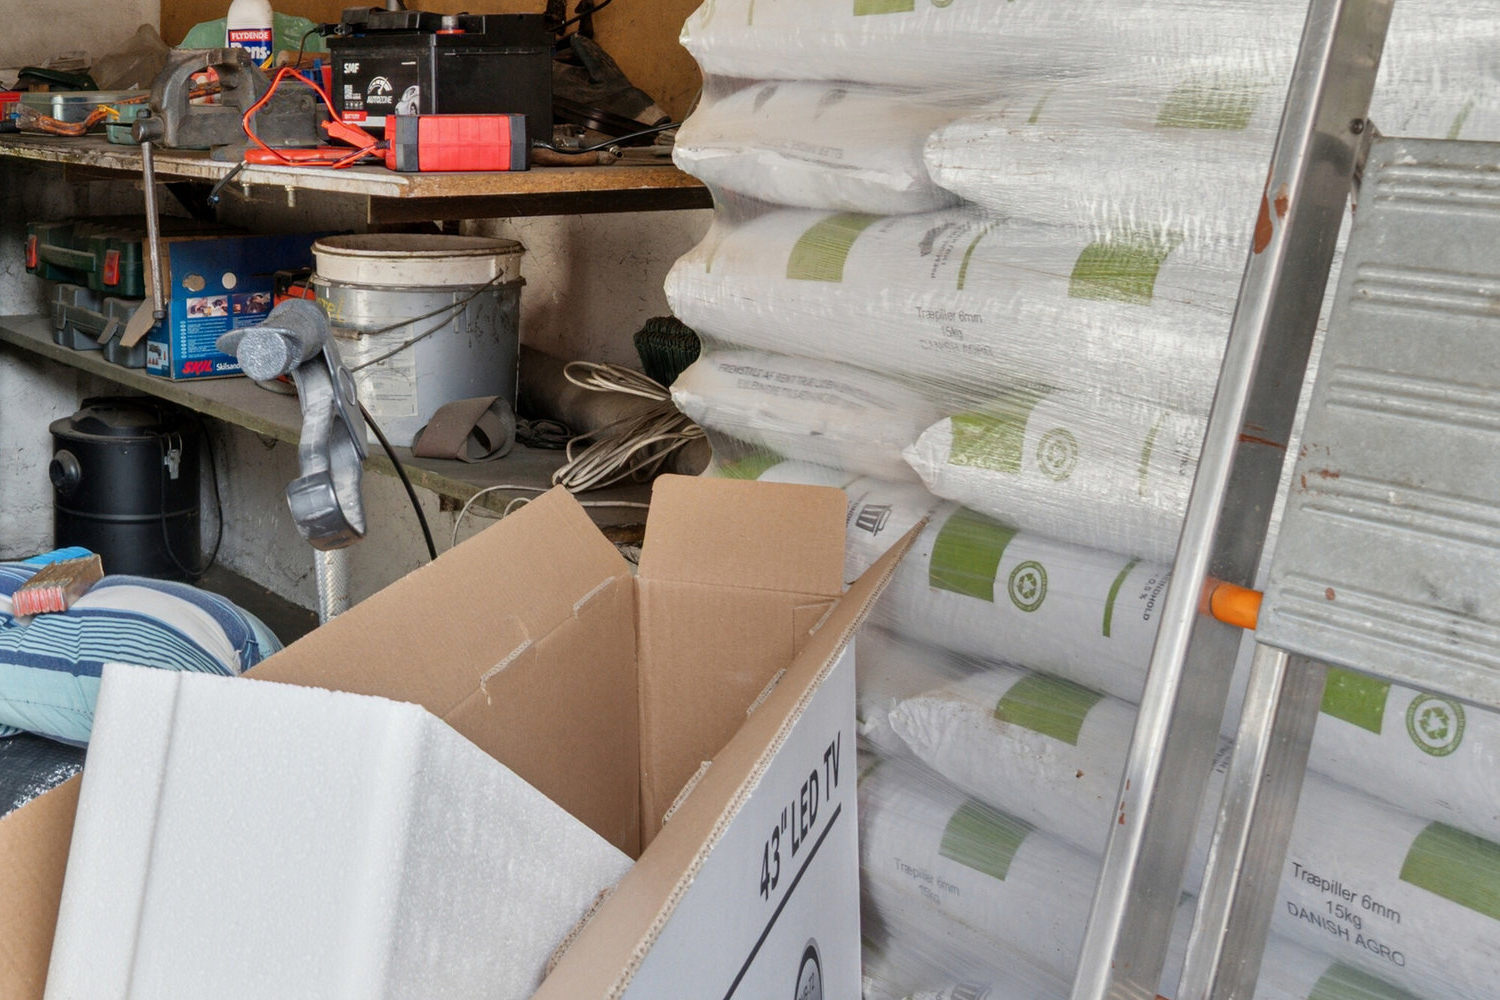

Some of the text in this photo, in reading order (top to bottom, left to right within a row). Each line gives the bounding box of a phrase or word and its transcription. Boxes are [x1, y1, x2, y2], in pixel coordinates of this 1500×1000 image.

[231, 31, 269, 40] FLYDENDE
[182, 360, 213, 374] SKIL
[759, 730, 841, 901] 43" LED TV
[1292, 861, 1401, 924] Træpiller 6mm
[1326, 900, 1363, 930] 15kg
[1286, 901, 1406, 967] DANISH AGRO
